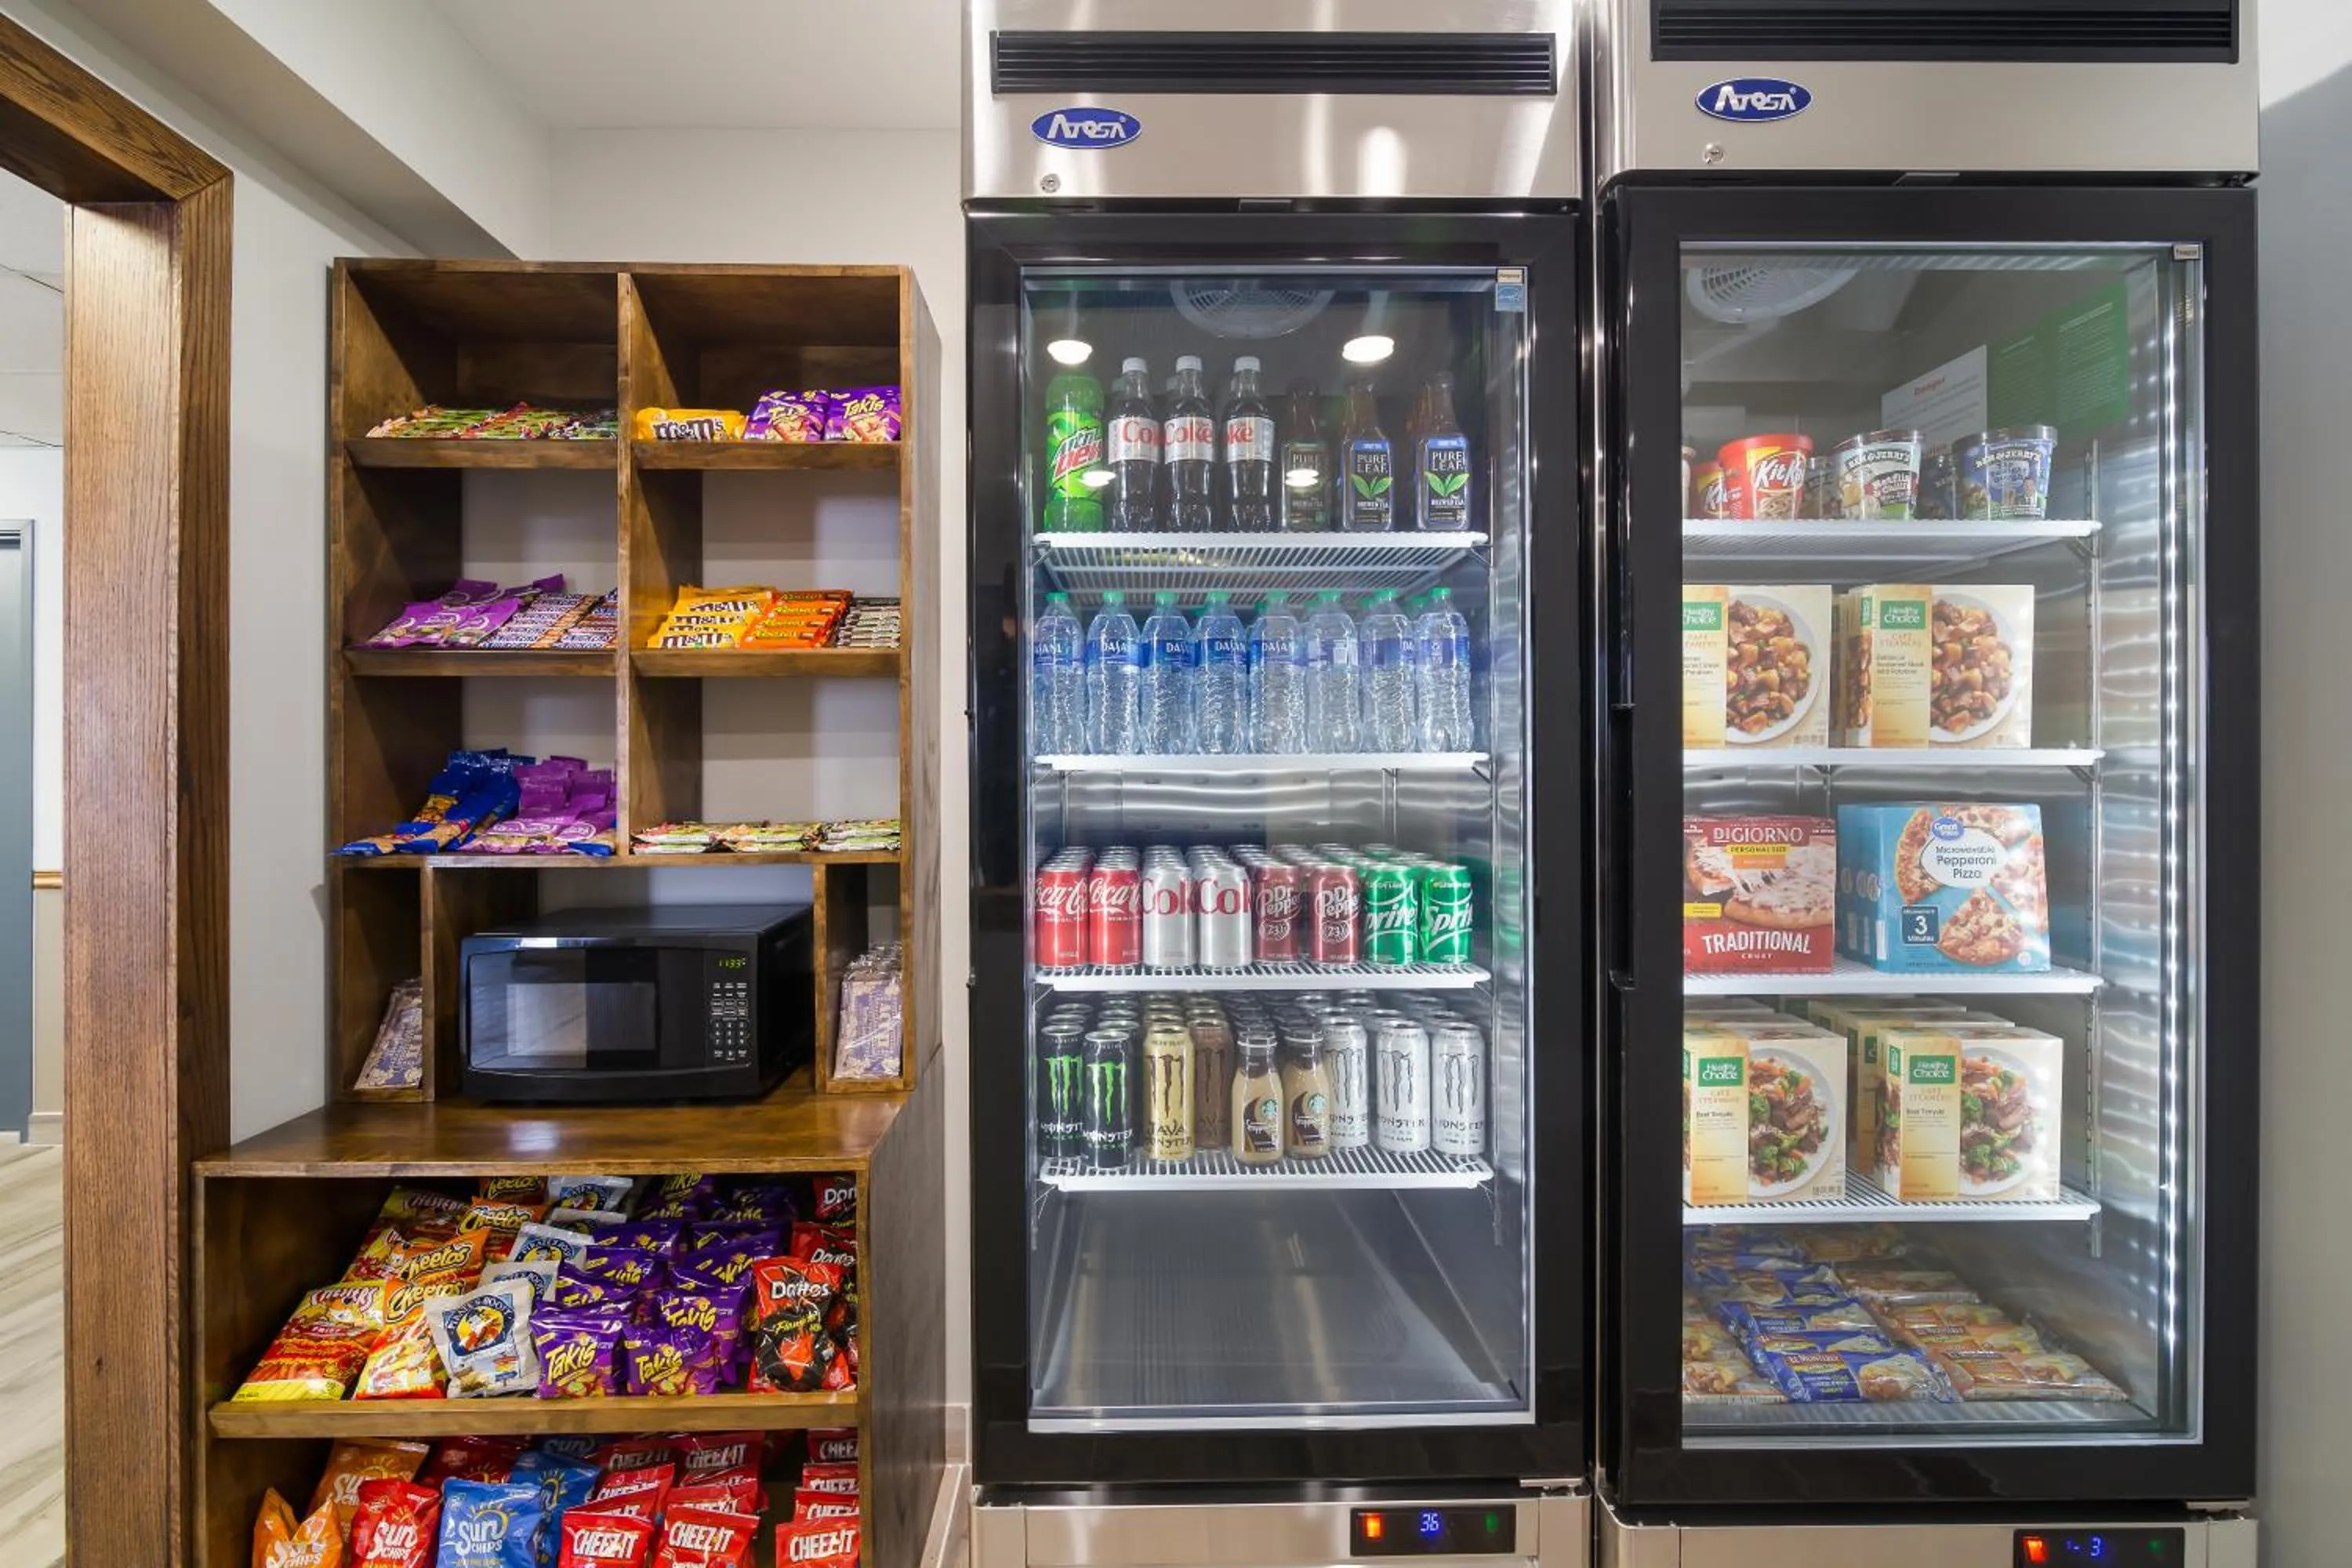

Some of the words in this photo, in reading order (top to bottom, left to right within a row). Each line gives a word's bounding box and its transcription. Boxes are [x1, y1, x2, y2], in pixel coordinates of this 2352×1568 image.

[1936, 855, 1997, 867] Pepperoni
[1953, 868, 1983, 879] Pizza
[1914, 915, 1928, 935] 3
[1701, 931, 1811, 954] TRADITIONAL
[771, 1280, 830, 1300] Doritos
[546, 1339, 597, 1385] Takis
[635, 1348, 683, 1381] Takis
[454, 1519, 507, 1556] Sun
[471, 1539, 503, 1555] CHIPS
